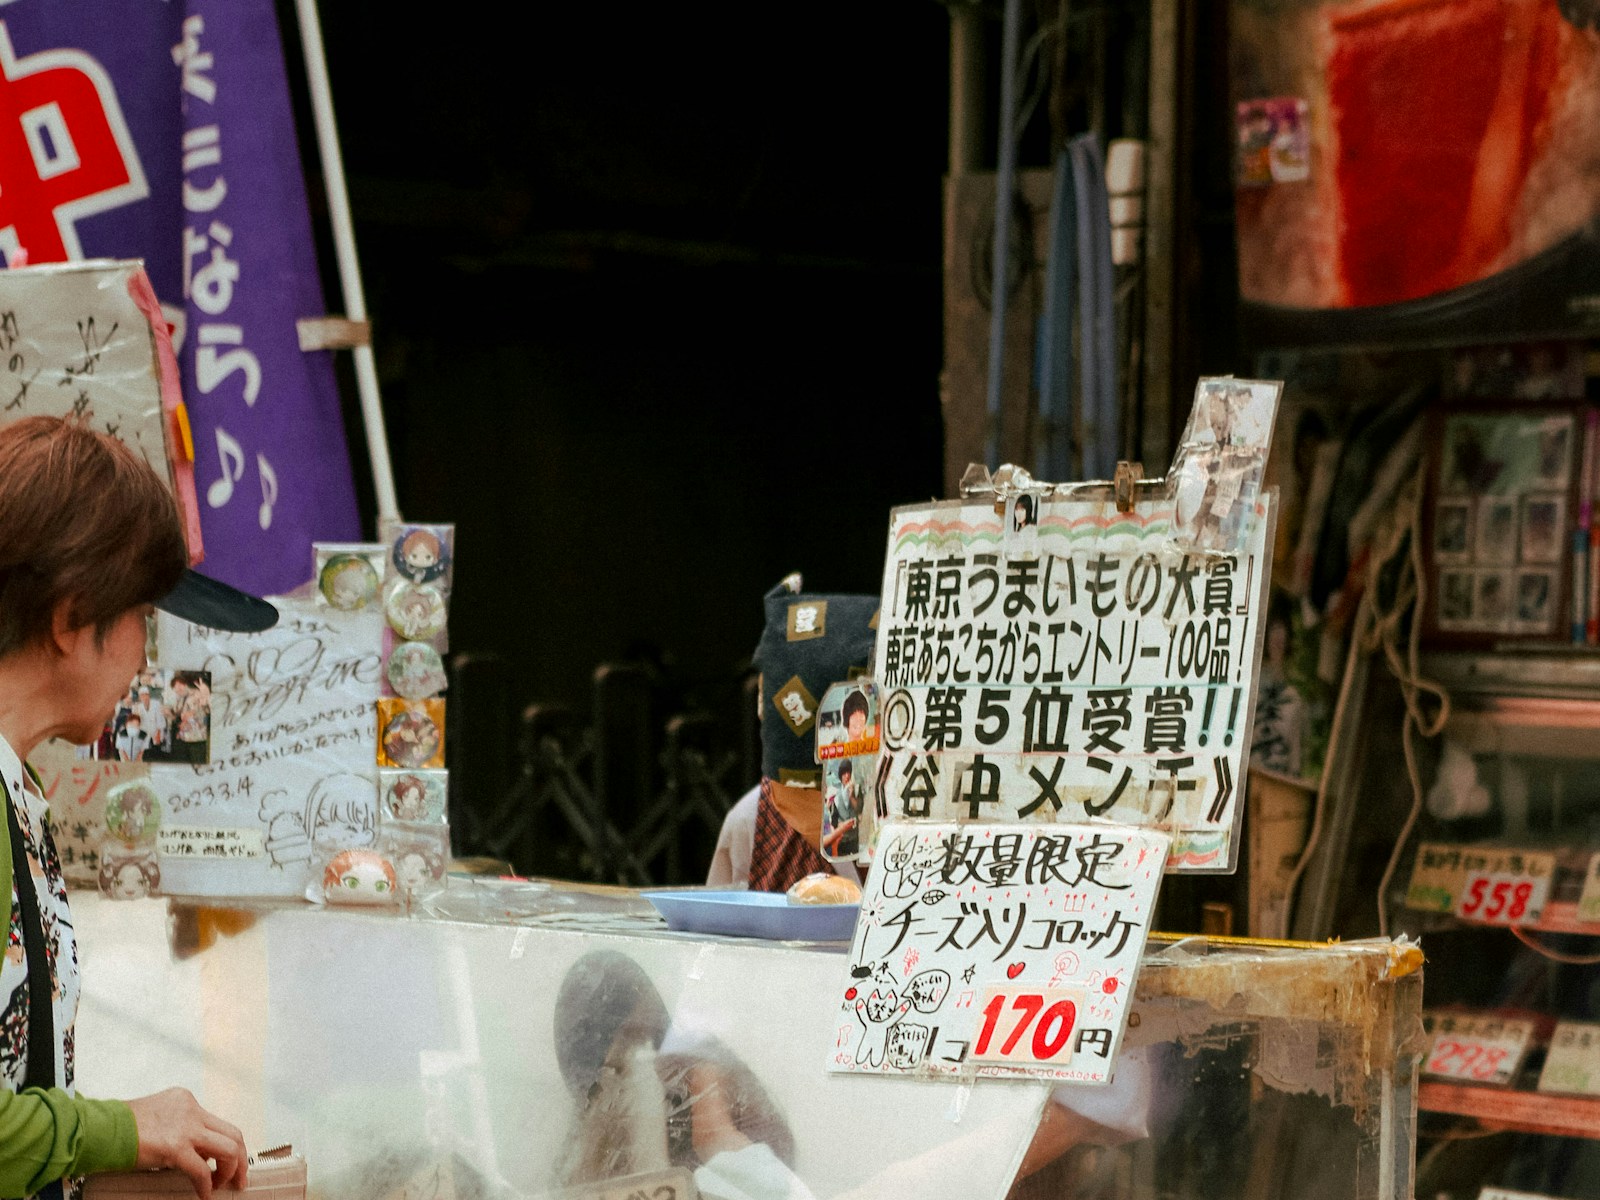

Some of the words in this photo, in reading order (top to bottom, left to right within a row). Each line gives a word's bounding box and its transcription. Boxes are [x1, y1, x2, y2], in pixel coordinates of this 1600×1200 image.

[892, 553, 1255, 619] 『東京うまいもの大賞』
[874, 754, 1234, 824] 《谷中メンチ》
[925, 833, 1134, 891] 数量限定
[880, 899, 1142, 962] チーズ入りコロッケ
[1462, 879, 1534, 920] 558
